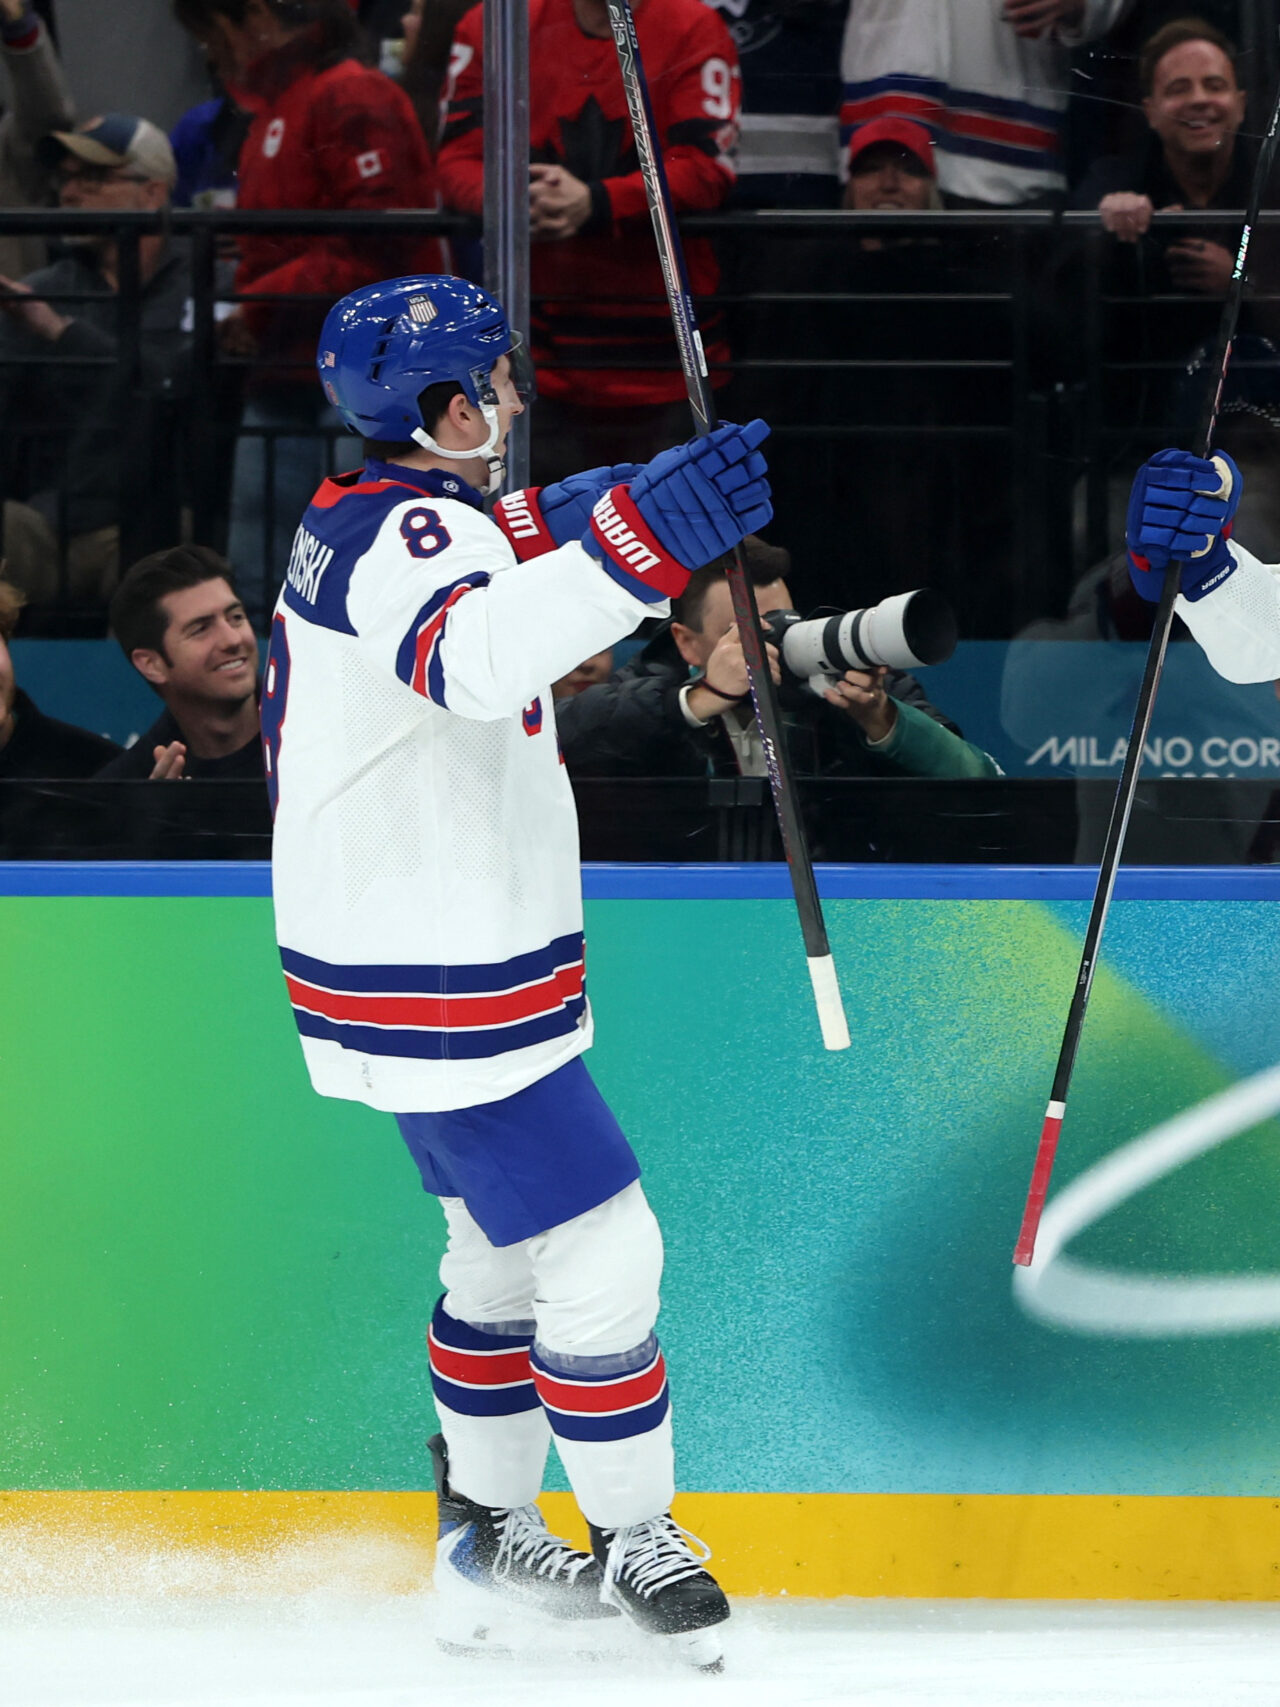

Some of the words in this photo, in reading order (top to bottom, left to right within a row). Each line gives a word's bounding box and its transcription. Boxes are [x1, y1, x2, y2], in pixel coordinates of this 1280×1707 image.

[625, 8, 639, 49] CCM
[1236, 225, 1251, 270] BAUER
[400, 506, 452, 559] 8
[1201, 565, 1231, 591] BAUER
[1026, 737, 1193, 767] MILANO
